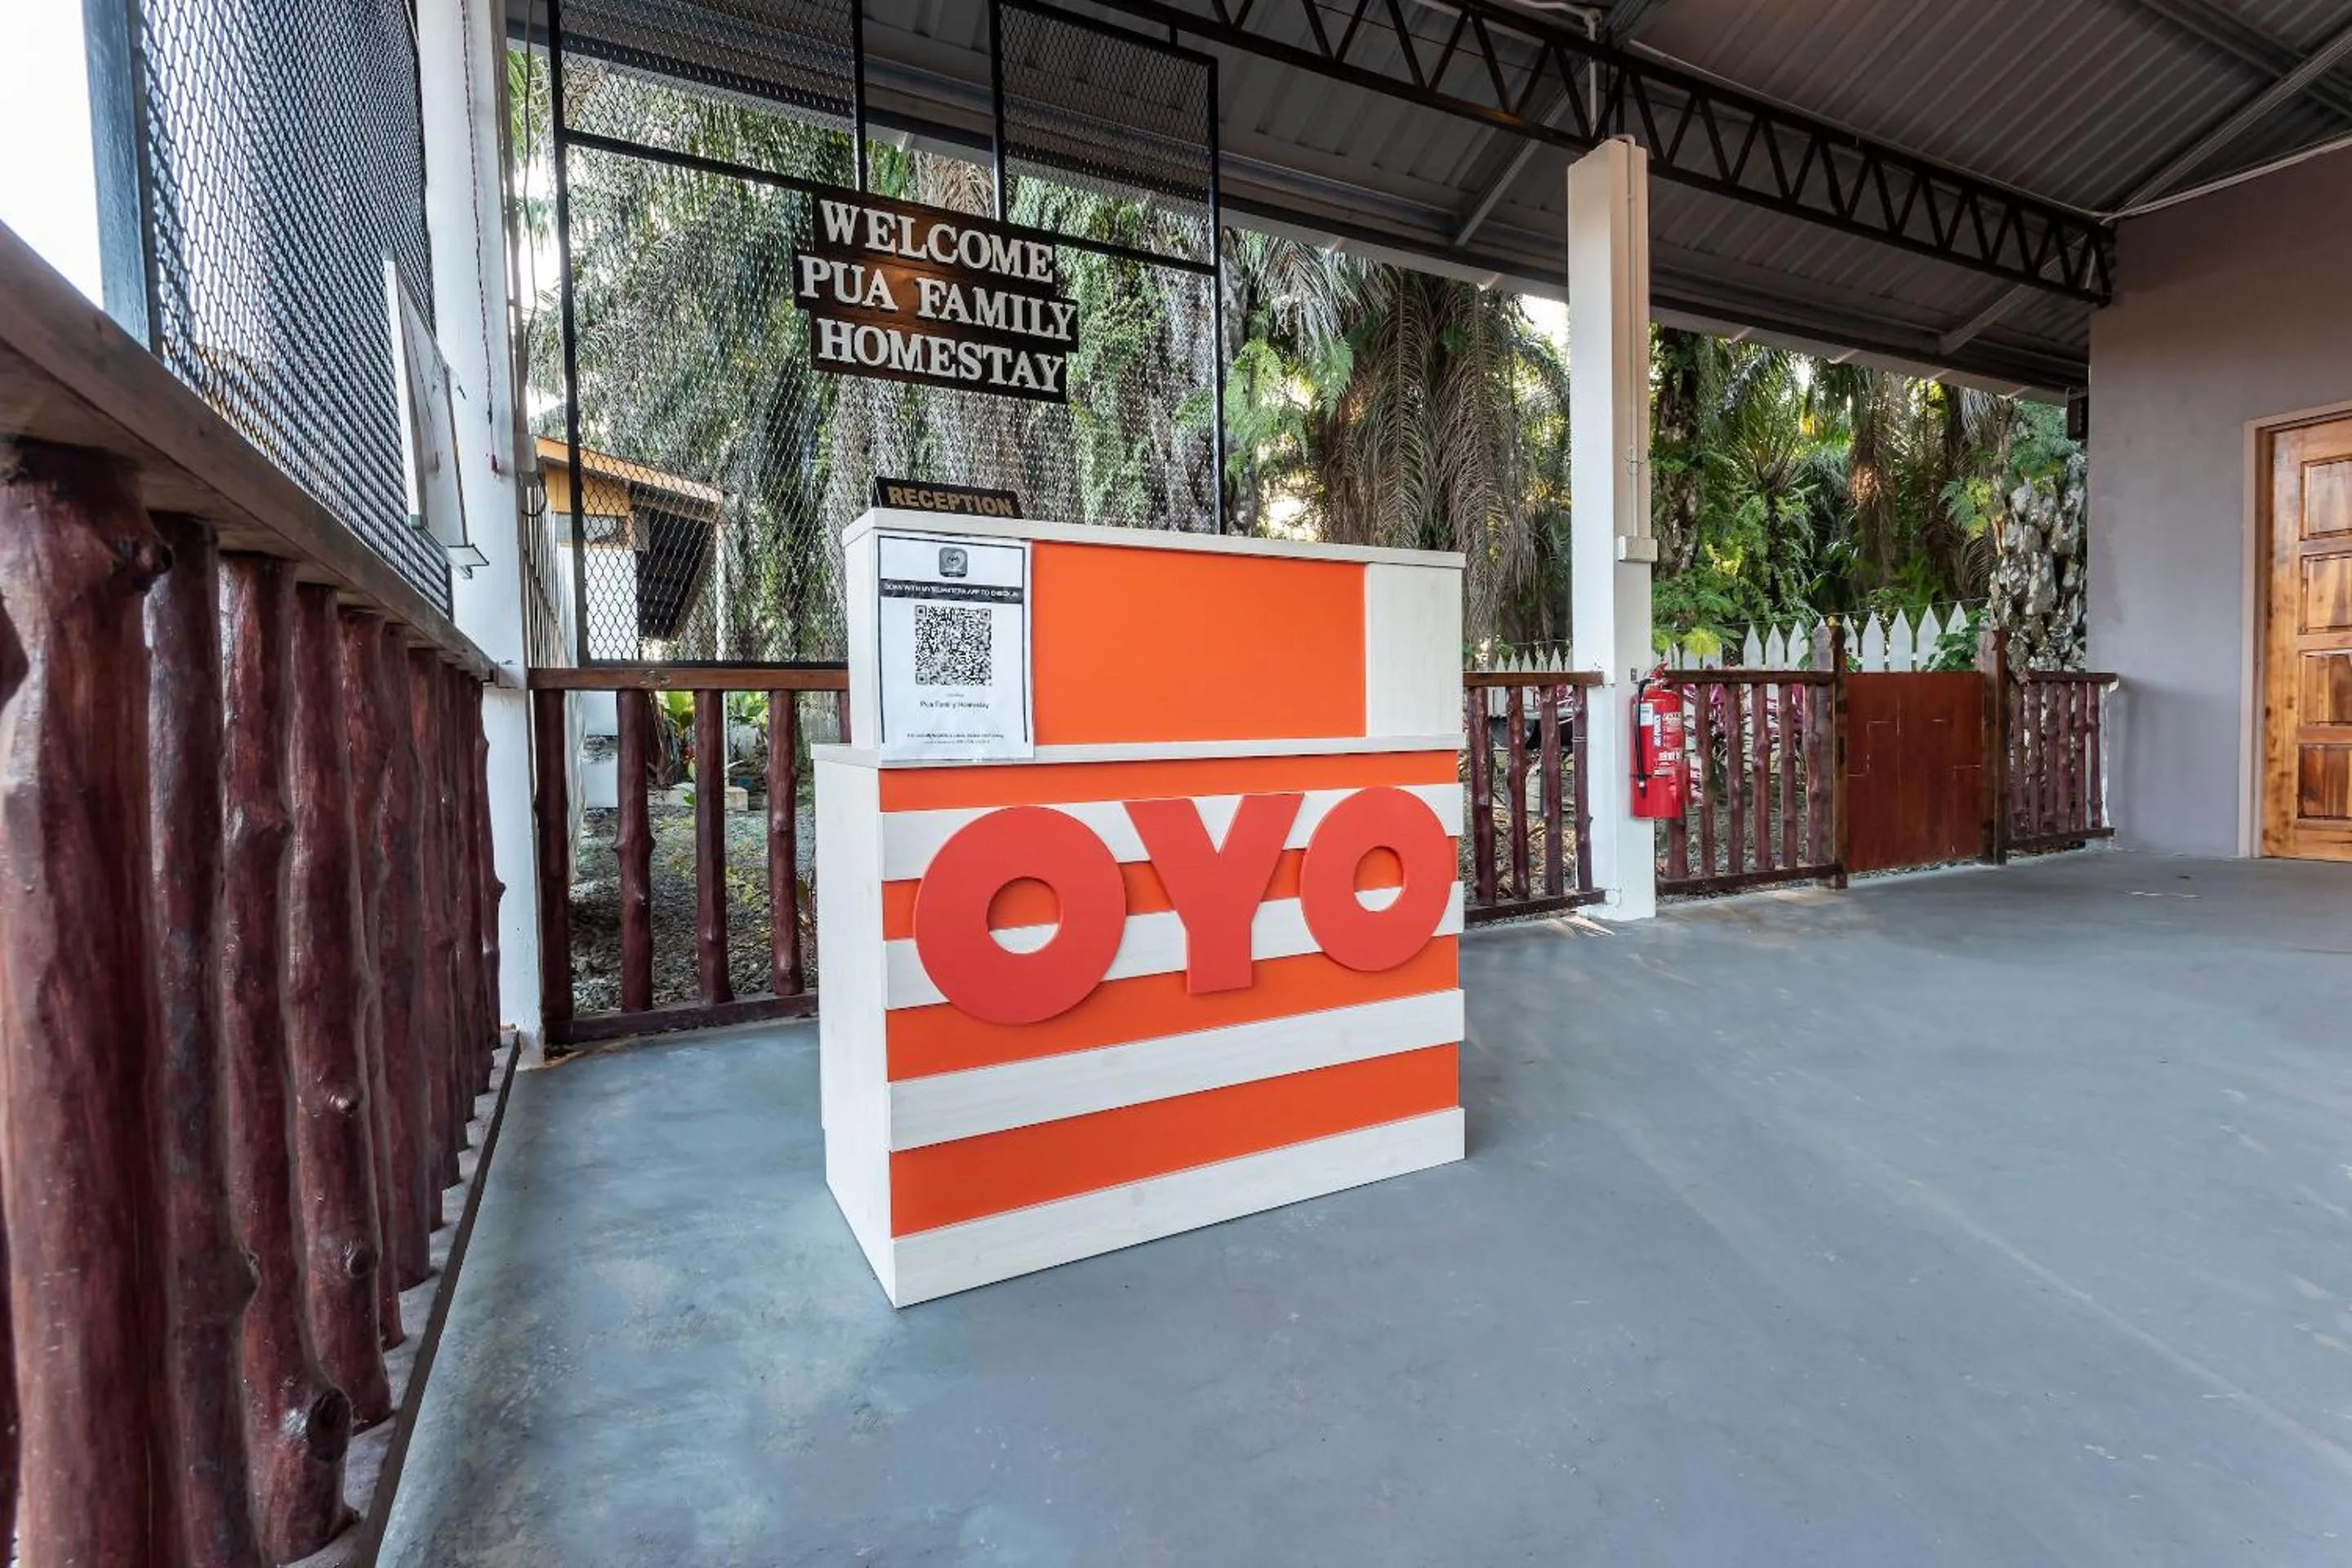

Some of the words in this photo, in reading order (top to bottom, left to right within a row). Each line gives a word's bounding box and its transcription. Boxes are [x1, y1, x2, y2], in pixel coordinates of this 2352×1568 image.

[819, 199, 1054, 283] WELCOME
[798, 255, 898, 310] PUA
[915, 276, 1076, 341] FAMILY
[817, 318, 1064, 392] HOMESTAY
[887, 486, 1013, 516] RECEPTION
[935, 700, 956, 709] Famy
[913, 786, 1455, 1025] OYO
